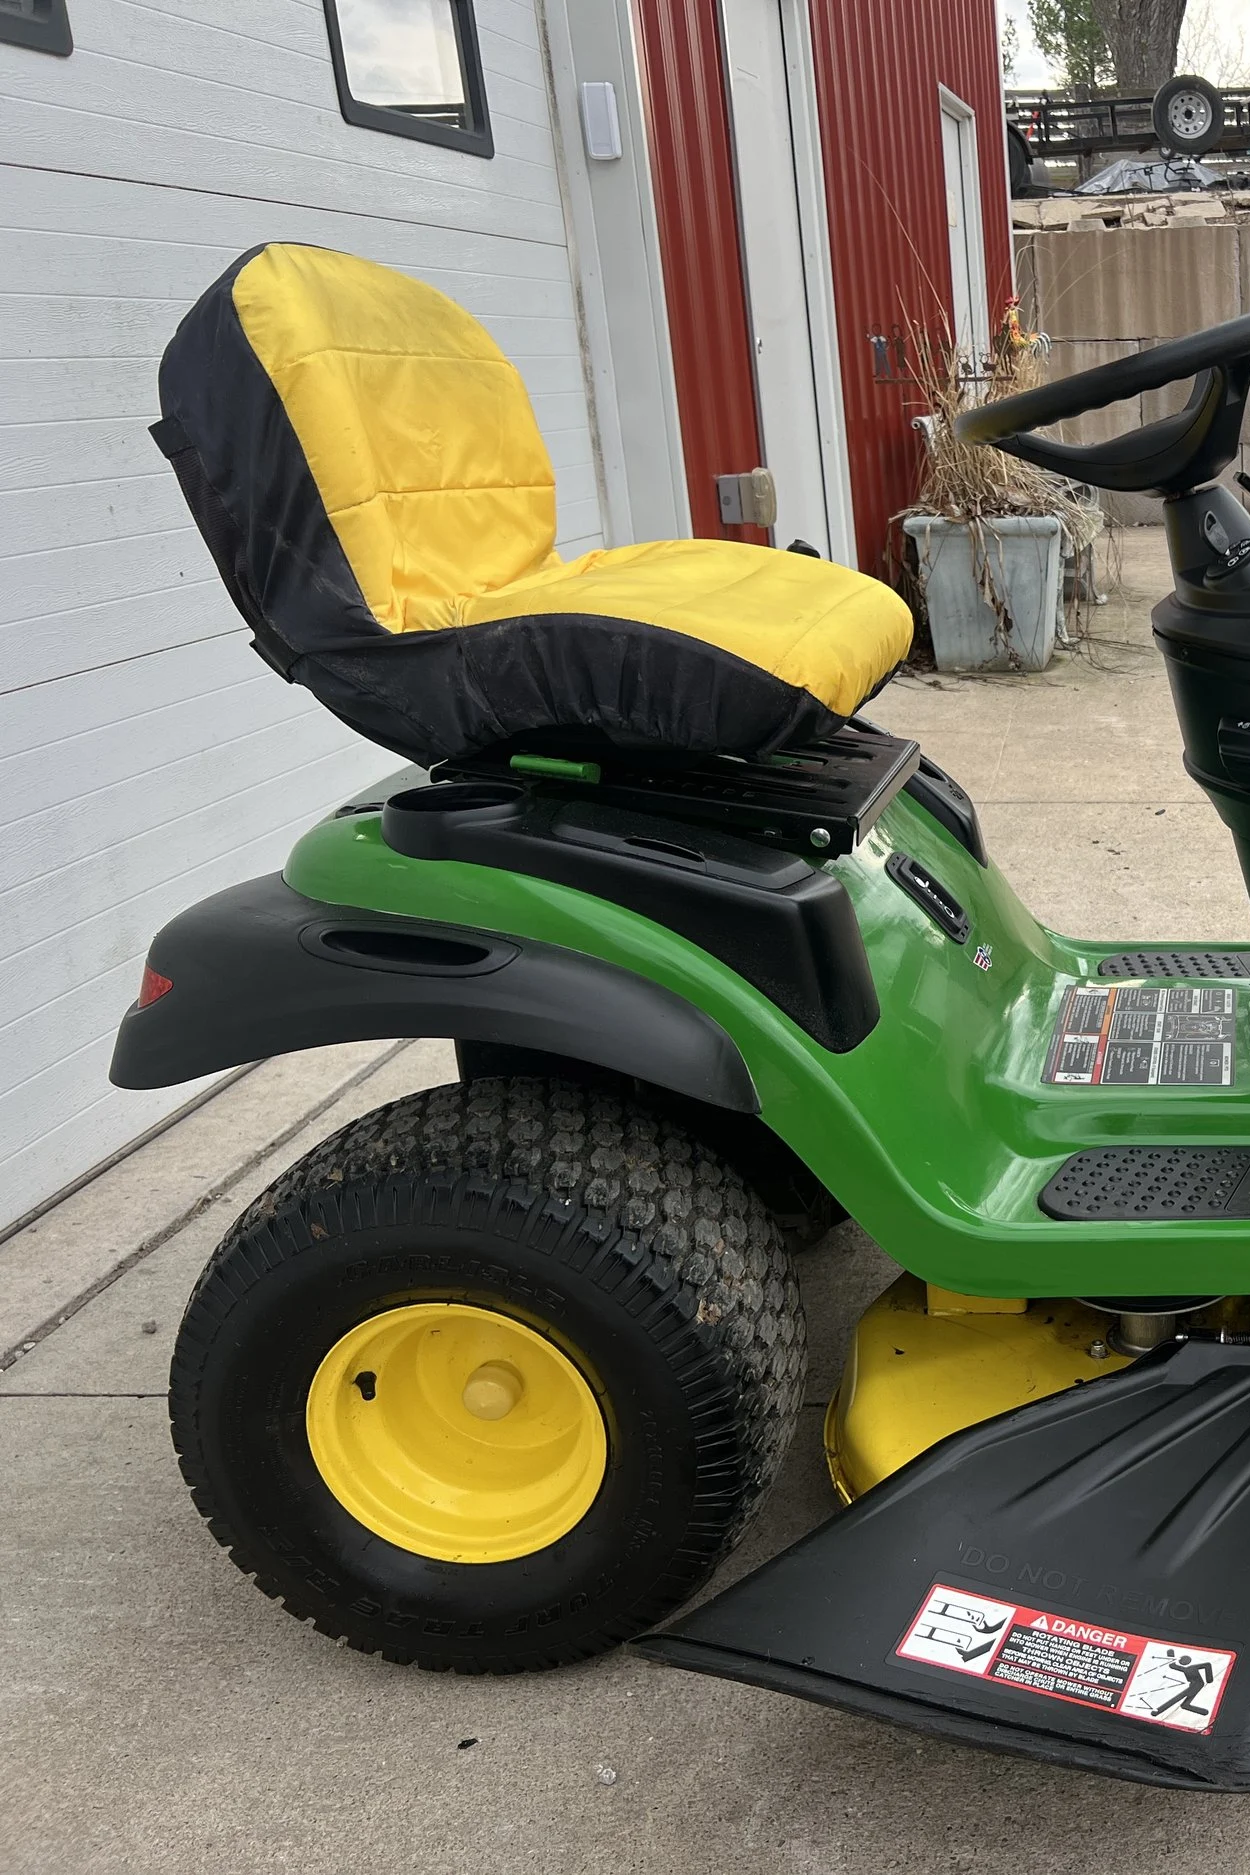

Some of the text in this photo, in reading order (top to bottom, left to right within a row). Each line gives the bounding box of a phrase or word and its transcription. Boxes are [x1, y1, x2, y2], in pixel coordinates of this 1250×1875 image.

[960, 1546, 1242, 1627] DO NOT REMOVE
[1032, 1631, 1115, 1657] ROTATING BLADE
[1052, 1620, 1128, 1649] DANGER
[1003, 1648, 1027, 1658] BEFORE
[1052, 1661, 1071, 1670] CLEAR
[1072, 1667, 1088, 1675] AREA
[1097, 1673, 1123, 1684] OBJECTS
[1022, 1646, 1110, 1674] THROWN OBJECTS
[1025, 1642, 1049, 1651] MOWER
[1050, 1648, 1068, 1657] WHEN
[1069, 1653, 1092, 1663] ENGINE
[1100, 1661, 1128, 1672] RUNNING
[1049, 1642, 1070, 1651] HANDS
[1081, 1650, 1098, 1658] FEET
[1098, 1655, 1120, 1664] UNDER
[994, 1671, 1025, 1683] CATCHER
[1033, 1682, 1054, 1691] PLACE
[1002, 1653, 1018, 1661] THAT
[1042, 1664, 1068, 1676] THROWN
[1078, 1674, 1099, 1684] BLADE
[1024, 1669, 1056, 1682] OPERATE
[1057, 1679, 1082, 1688] MOWER
[1083, 1685, 1114, 1697] WITHOUT
[997, 1667, 1033, 1680] DISCHARGE
[1033, 1677, 1055, 1686] CHUTE
[1066, 1686, 1089, 1695] ENTIRE
[1089, 1692, 1112, 1702] GRASS
